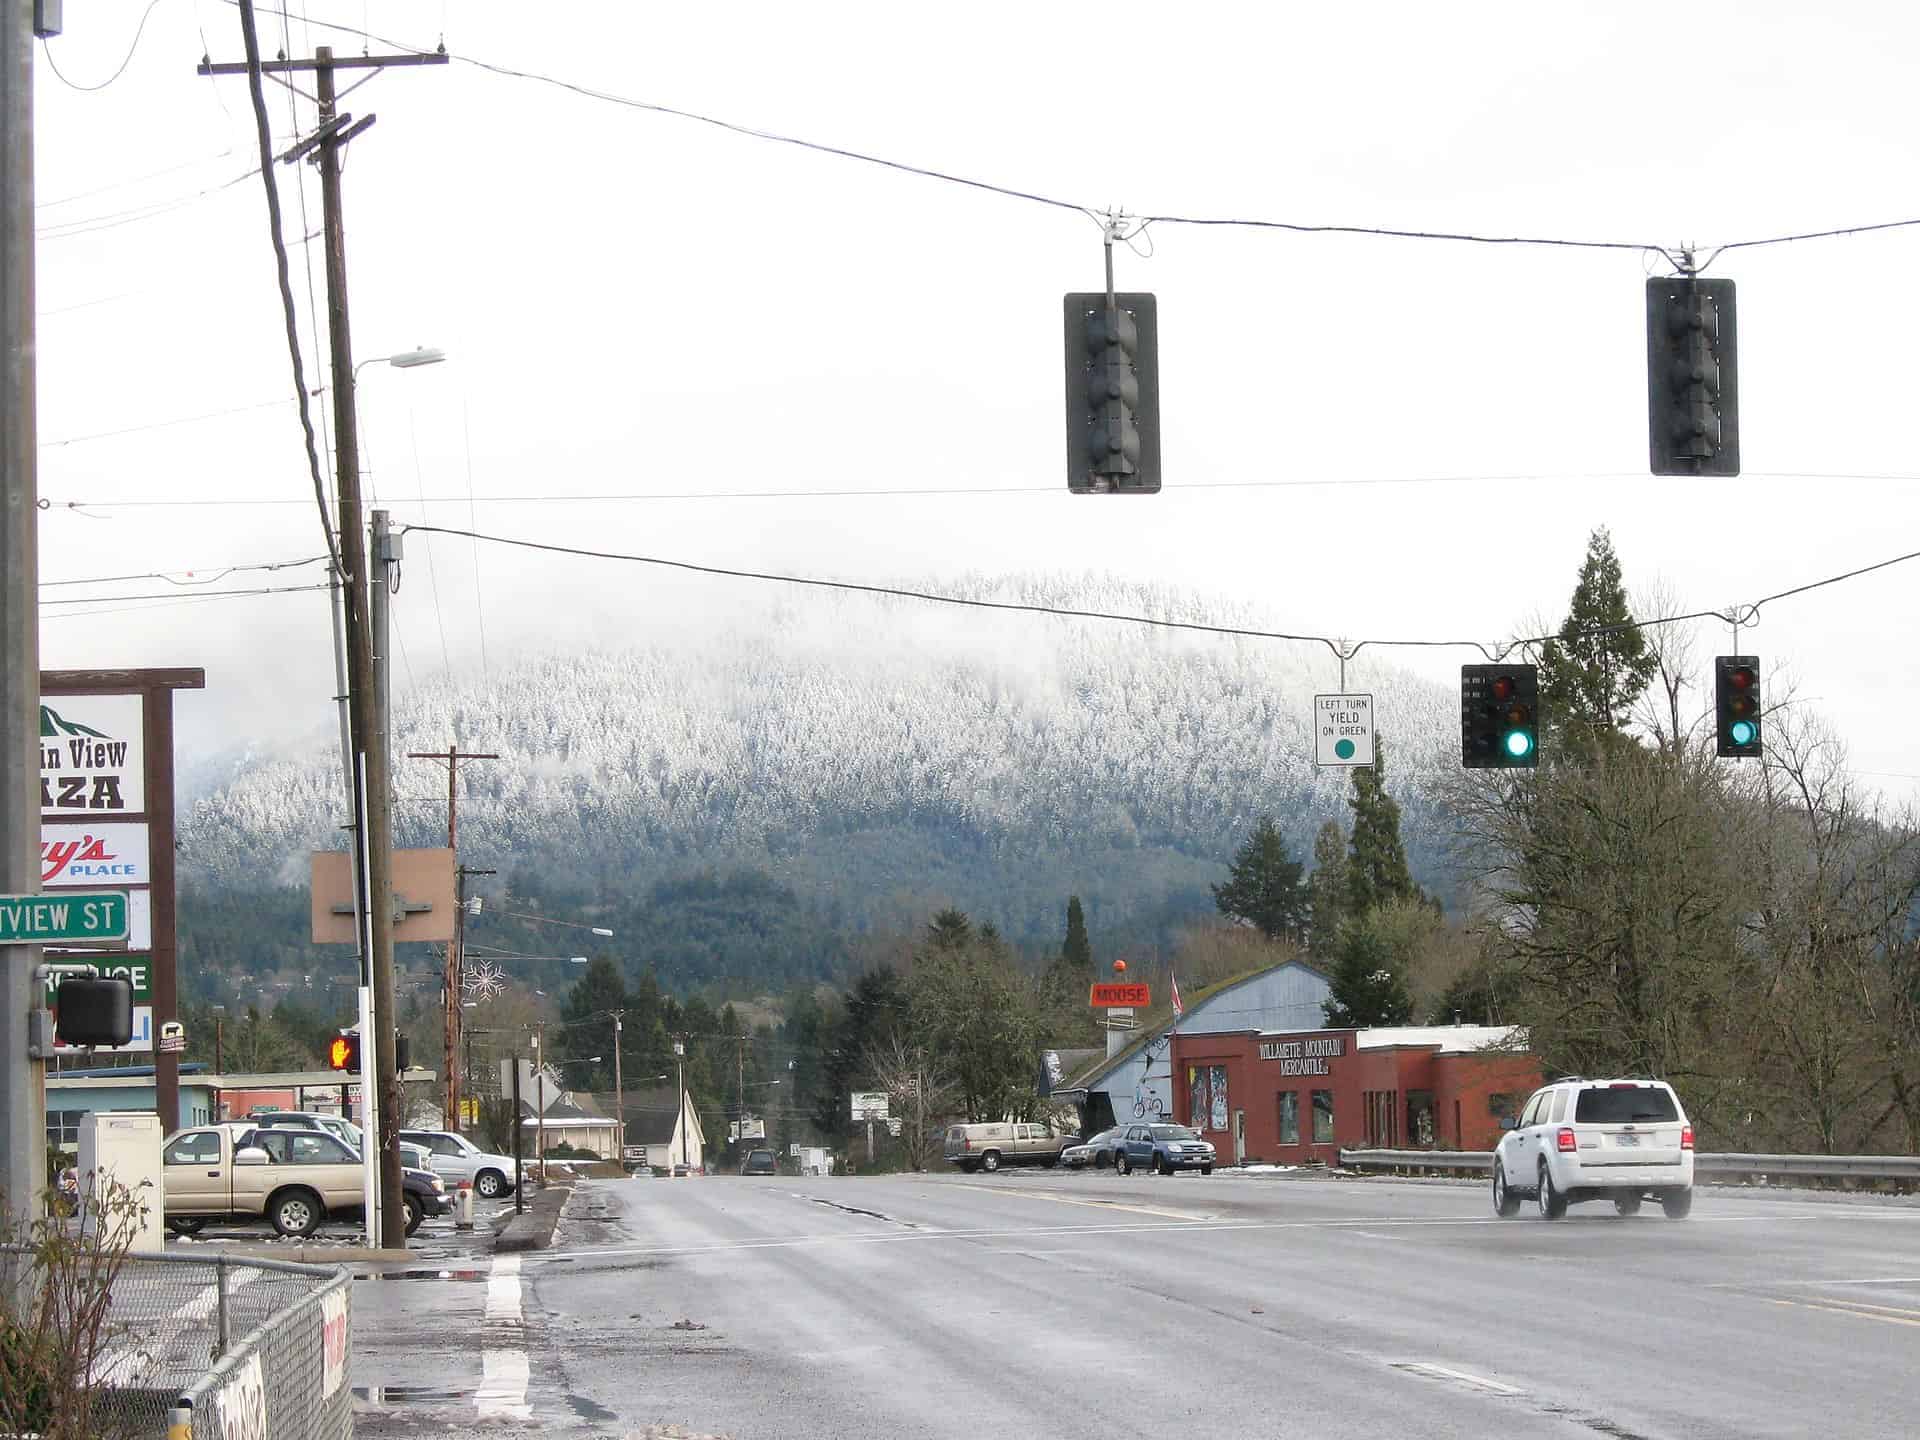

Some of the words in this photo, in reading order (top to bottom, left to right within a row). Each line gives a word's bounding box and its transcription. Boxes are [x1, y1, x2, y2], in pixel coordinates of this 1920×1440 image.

[1320, 700, 1340, 709] LEFT
[1346, 700, 1367, 708] TURN
[1330, 712, 1359, 723] YIELD
[1323, 727, 1334, 736] ON
[1340, 727, 1366, 735] GREEN
[40, 743, 61, 769] in
[69, 738, 127, 768] View
[70, 864, 136, 876] PLACE
[83, 902, 115, 929] ST
[1305, 1040, 1341, 1057] MOUNTAIN
